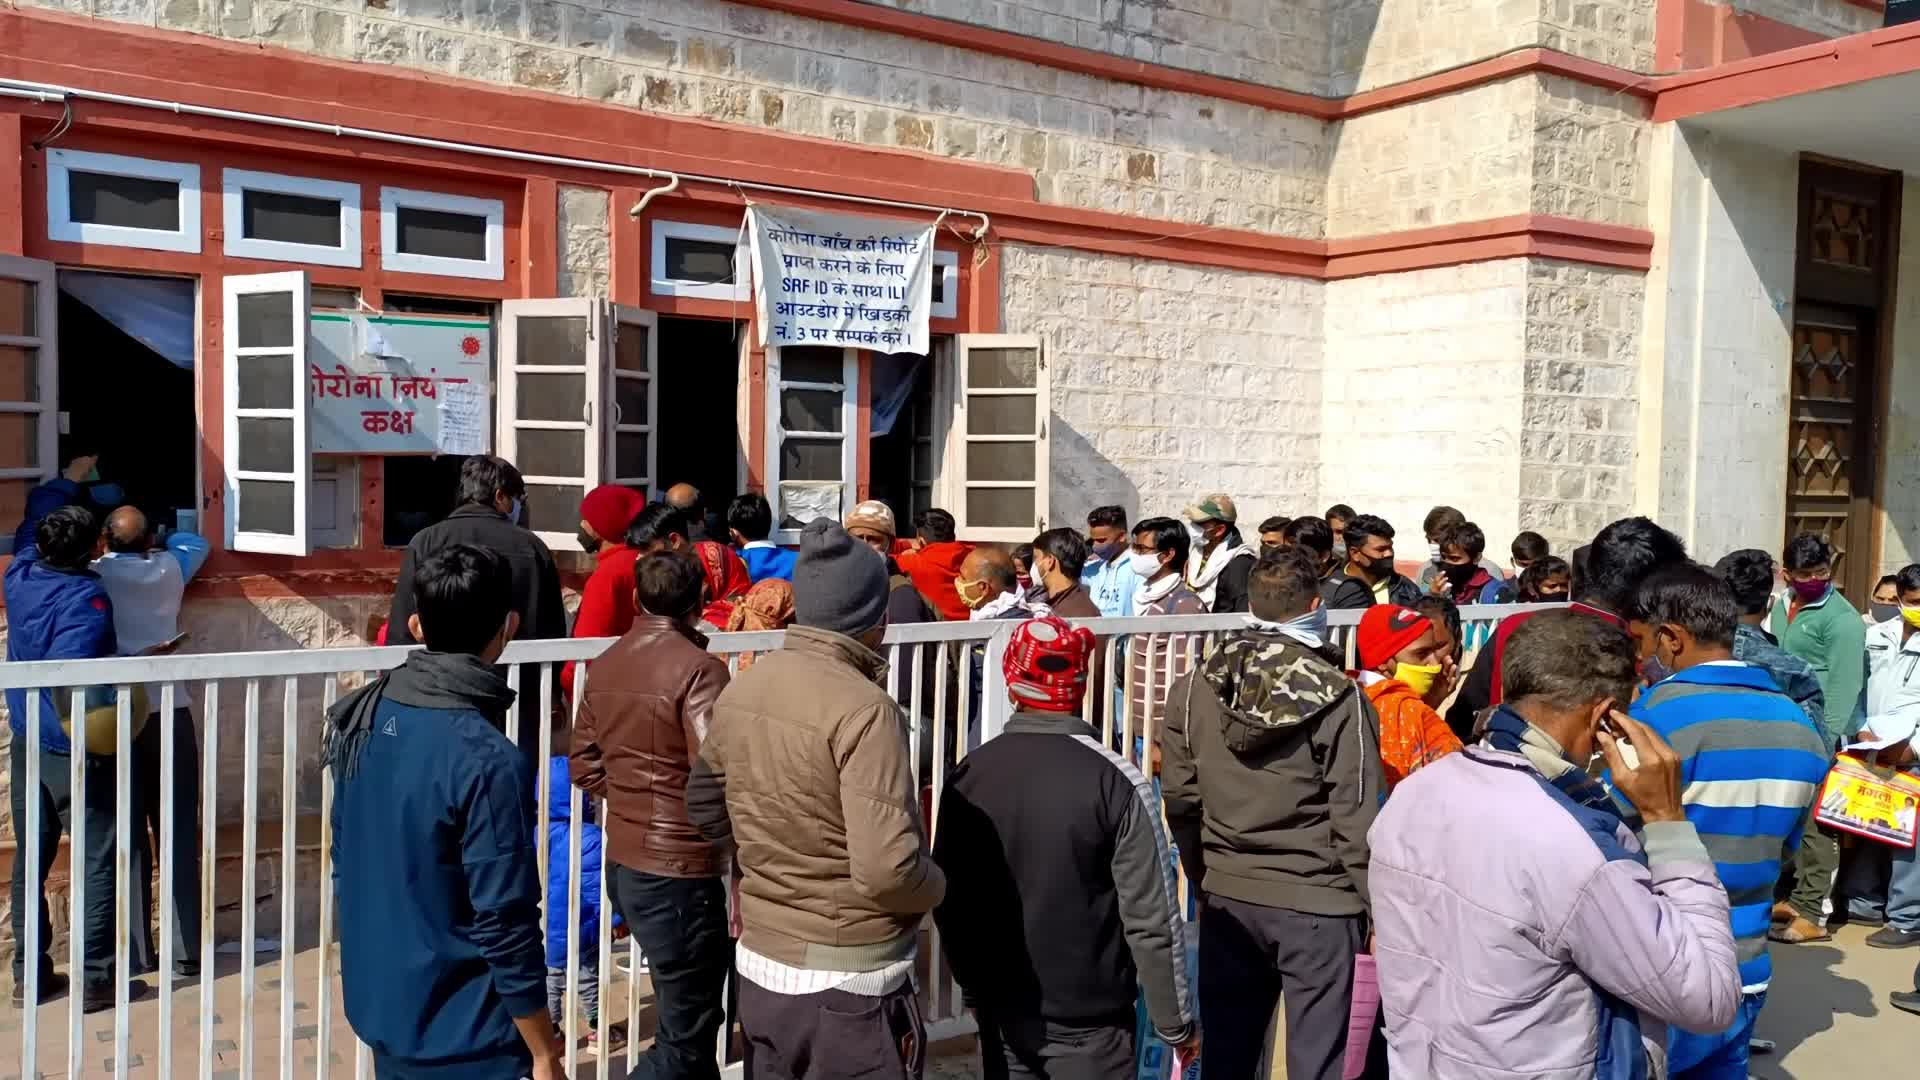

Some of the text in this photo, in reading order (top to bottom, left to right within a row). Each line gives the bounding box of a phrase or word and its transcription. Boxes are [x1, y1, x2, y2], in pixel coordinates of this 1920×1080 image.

[767, 224, 920, 255] कोरोना जाँच की रिपोर्ट
[783, 253, 906, 281] प्राप्त करने के लिए
[782, 277, 906, 300] SRF ID के साथ ILI
[775, 300, 838, 319] आउटडोर
[844, 301, 856, 320] में
[797, 327, 806, 341] 3
[810, 327, 829, 341] पर
[834, 325, 878, 344] सम्पर्क
[312, 362, 382, 399] ोरोना
[360, 409, 415, 434] कक्ष
